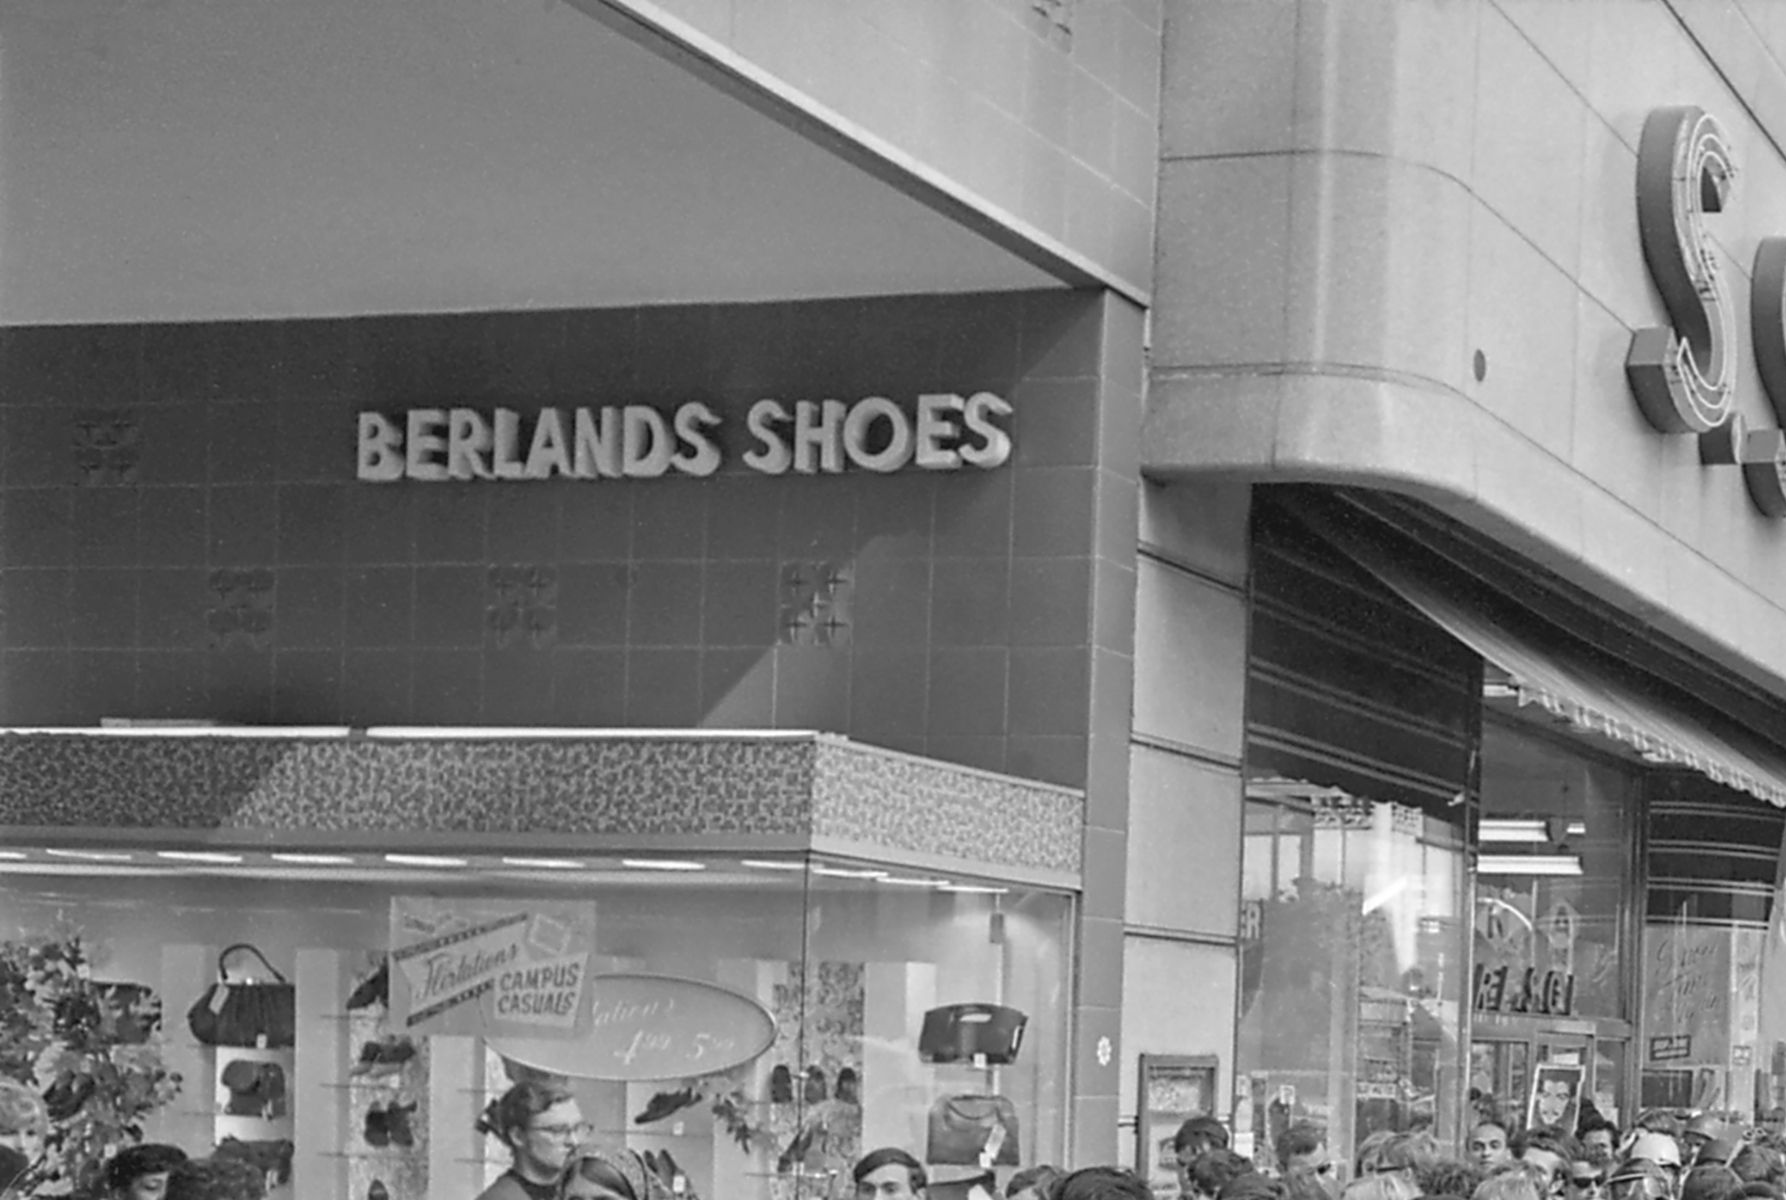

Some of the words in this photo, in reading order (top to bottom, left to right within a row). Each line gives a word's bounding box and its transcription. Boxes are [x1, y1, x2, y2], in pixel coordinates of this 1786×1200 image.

[357, 401, 722, 482] BERLANDS
[743, 392, 1013, 475] SHOES
[499, 961, 581, 992] CAMPUS
[497, 990, 576, 1017] CASUALS
